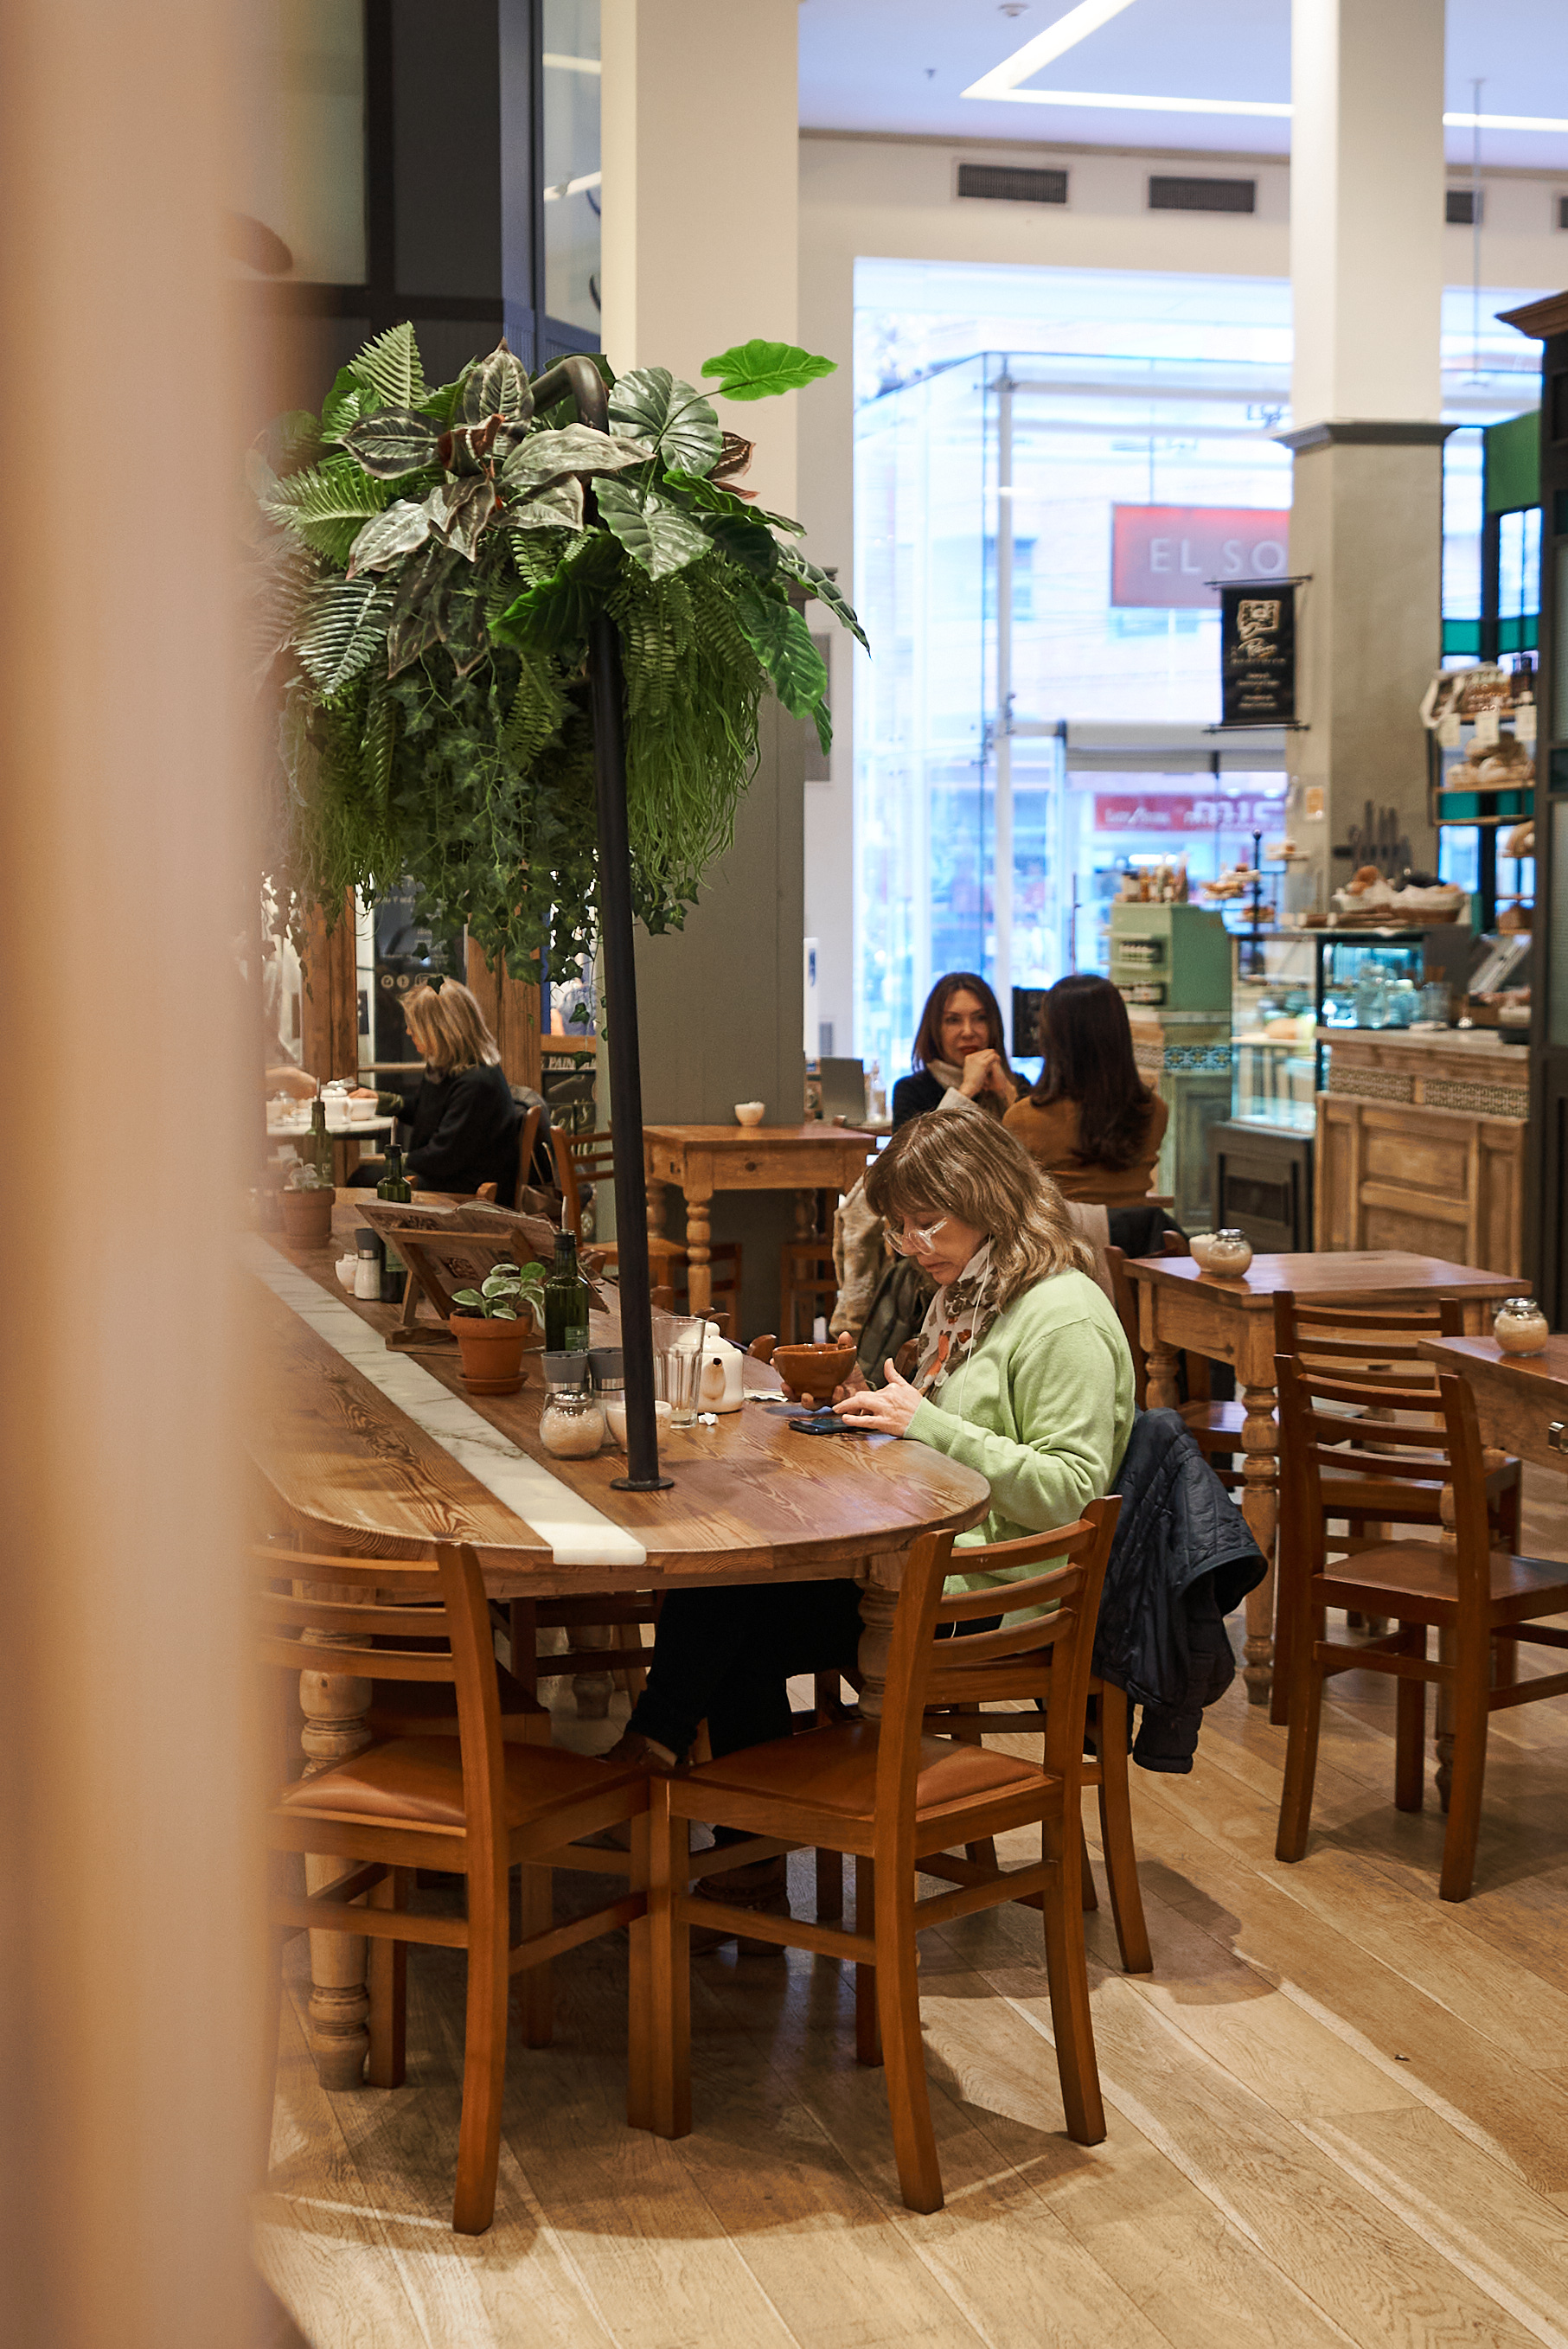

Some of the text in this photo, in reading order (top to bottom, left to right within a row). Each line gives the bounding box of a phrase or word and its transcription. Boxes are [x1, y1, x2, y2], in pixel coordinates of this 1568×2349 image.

[1150, 538, 1287, 574] EL SO
[548, 1057, 576, 1071] PAIN
